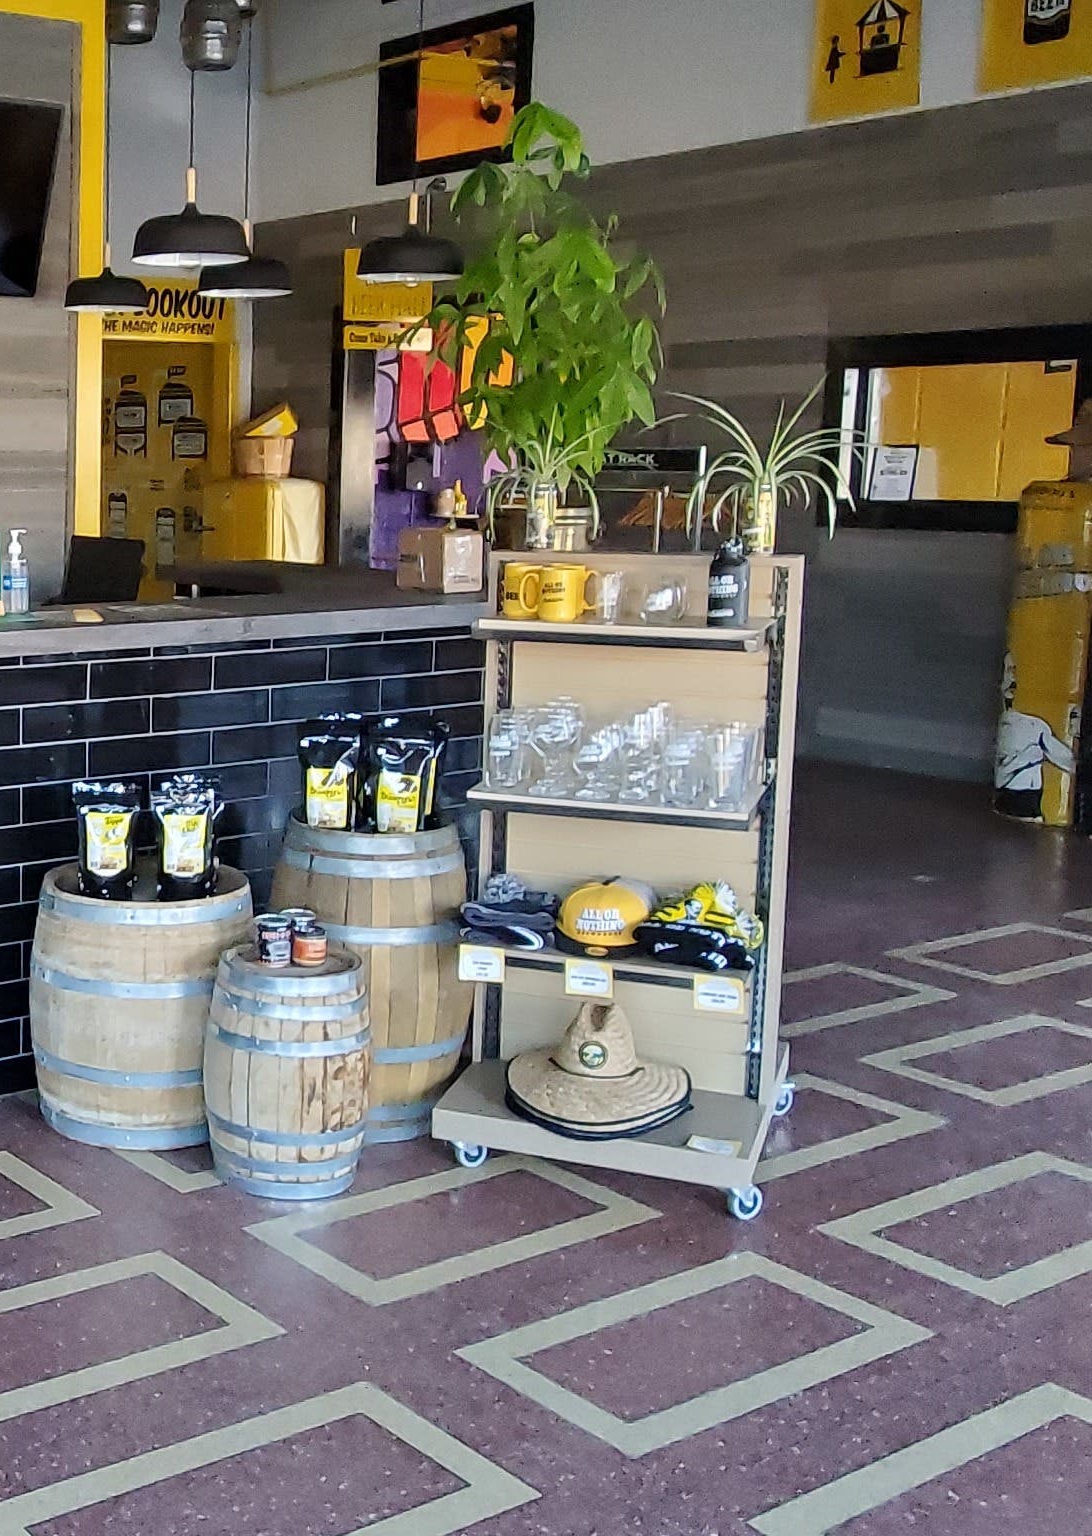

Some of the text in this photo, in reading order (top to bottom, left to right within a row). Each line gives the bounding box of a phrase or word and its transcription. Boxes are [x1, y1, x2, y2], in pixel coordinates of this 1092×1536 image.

[134, 288, 227, 320] OOKOUT
[102, 319, 119, 332] HE
[121, 319, 158, 333] MAGIC
